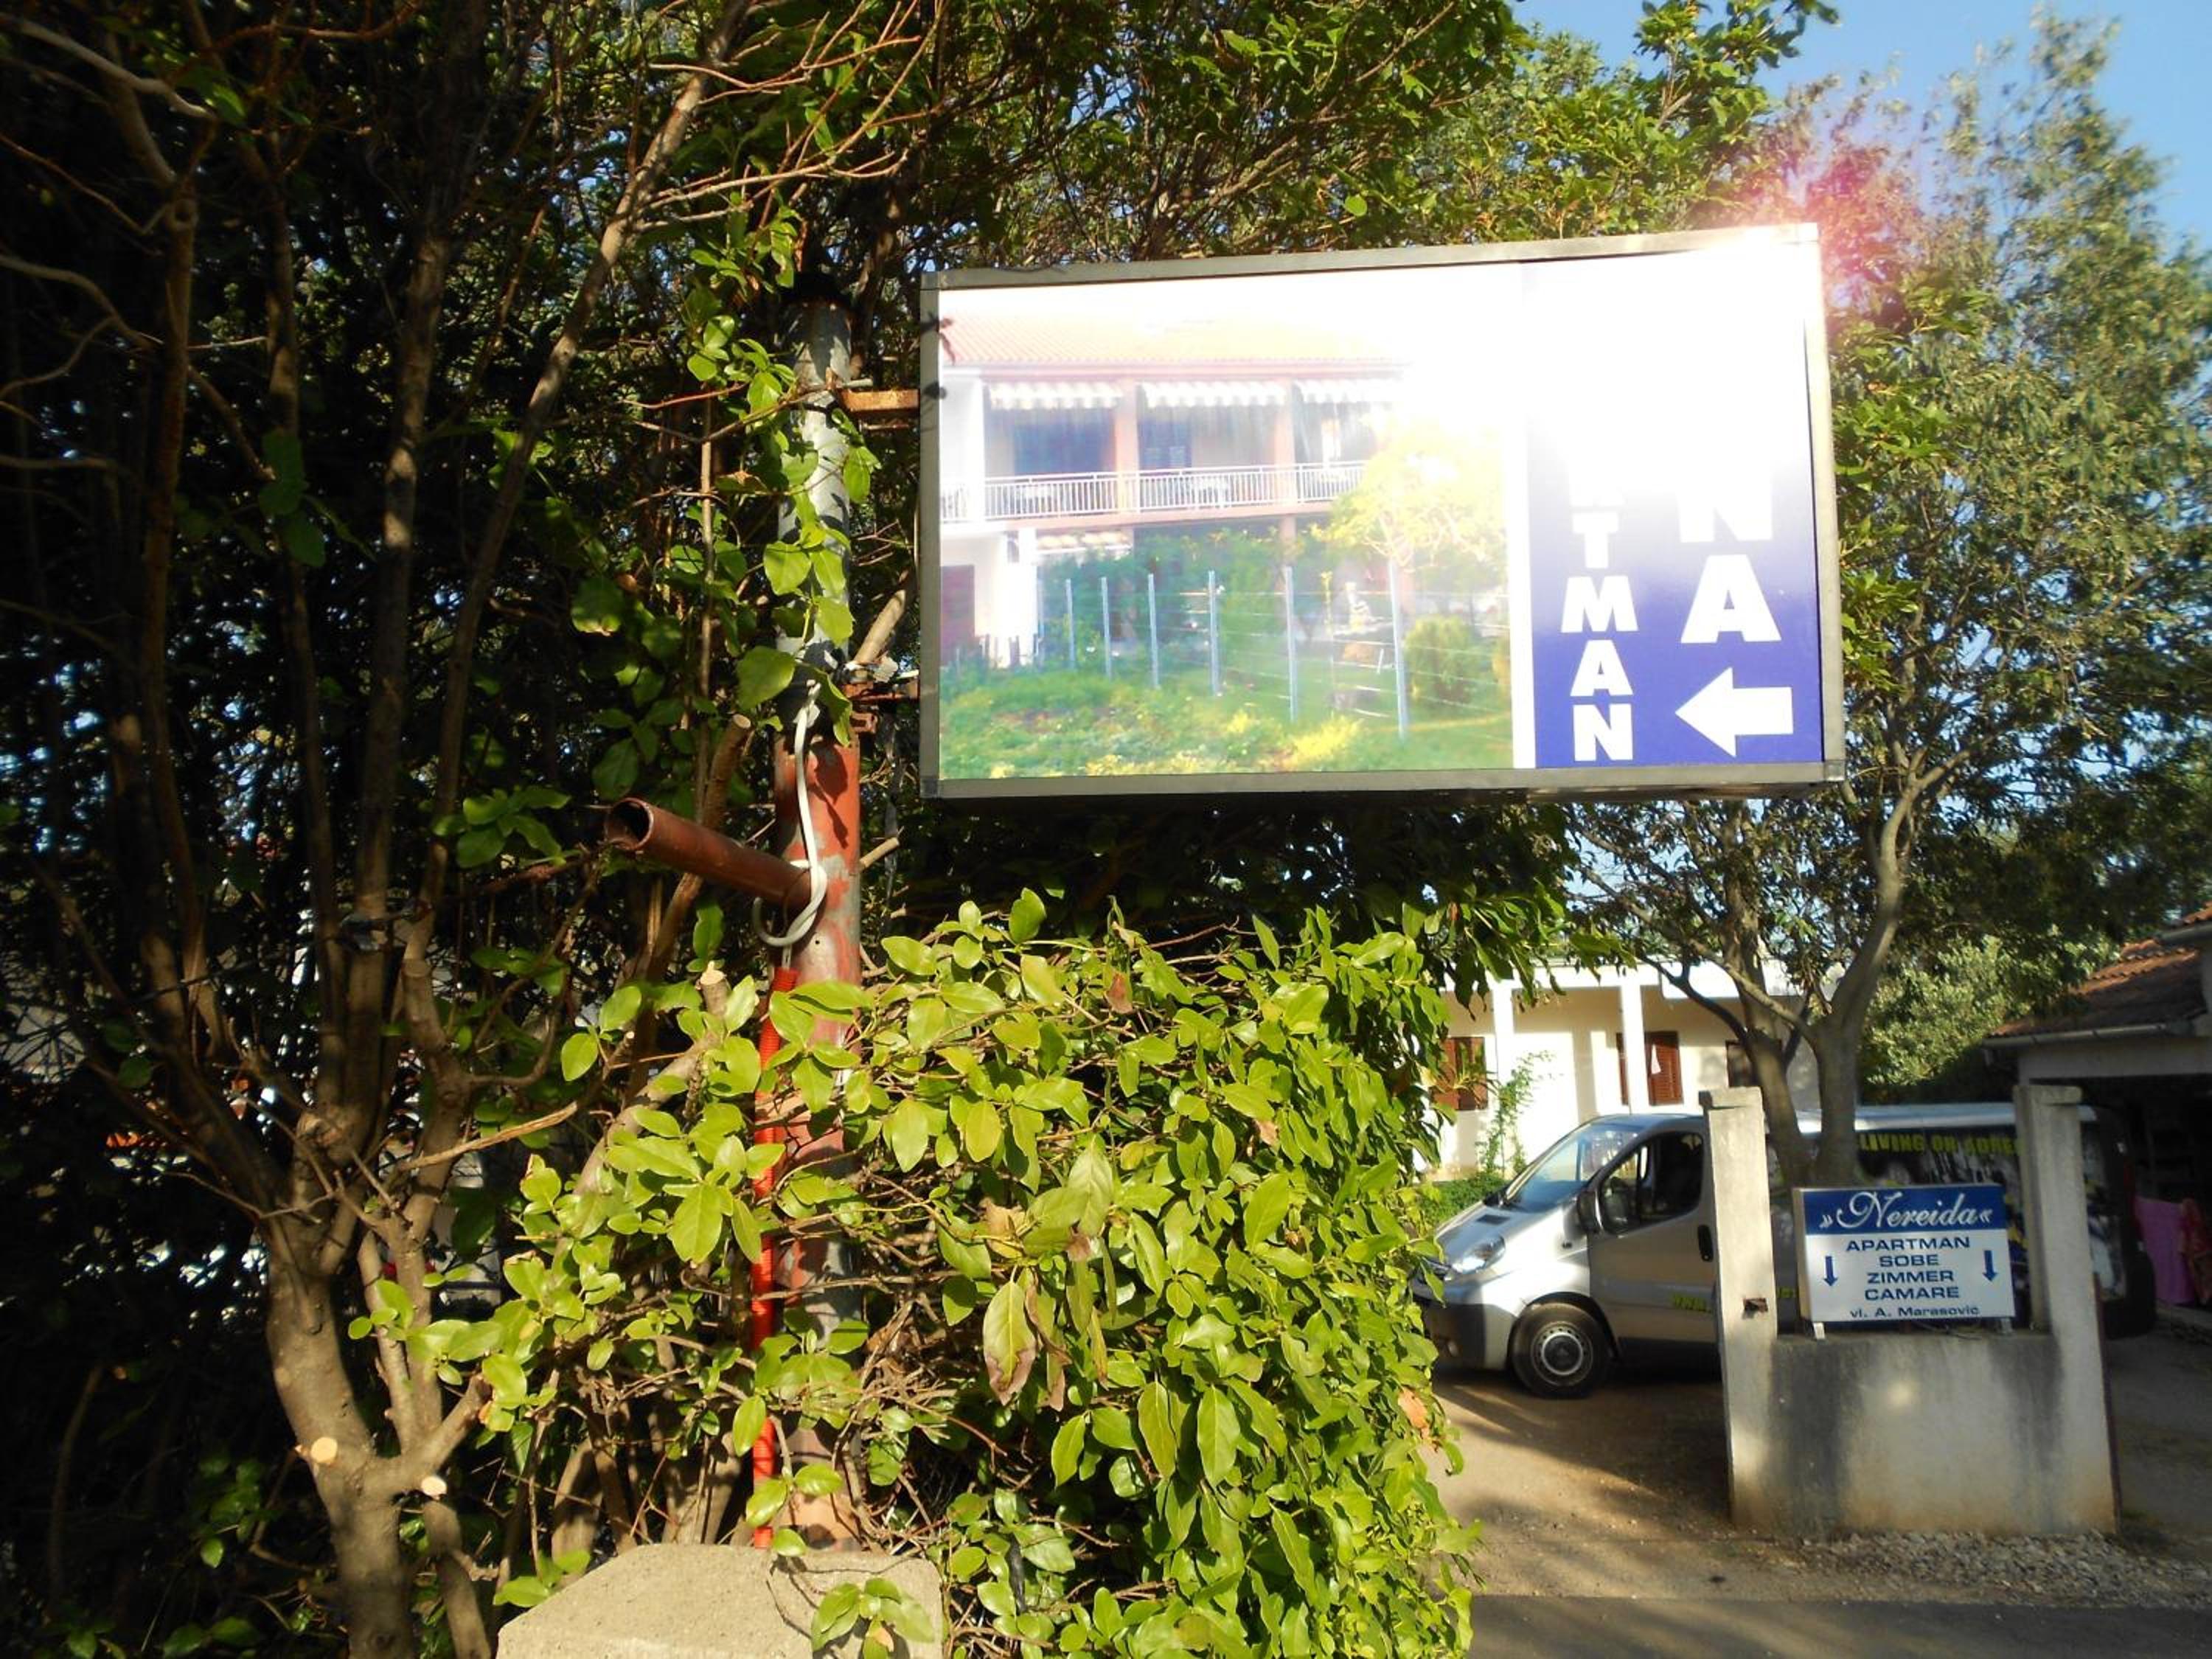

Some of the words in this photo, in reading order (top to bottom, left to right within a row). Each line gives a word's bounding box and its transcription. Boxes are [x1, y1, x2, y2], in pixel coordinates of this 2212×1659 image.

[1561, 485, 1638, 761] TMAN
[1846, 1237, 1971, 1252] APARTMAN
[1879, 1254, 1939, 1267] SOBE
[1866, 1270, 1955, 1284] ZIMMER
[1864, 1287, 1959, 1301] CAMARE
[1875, 1307, 1892, 1318] A.
